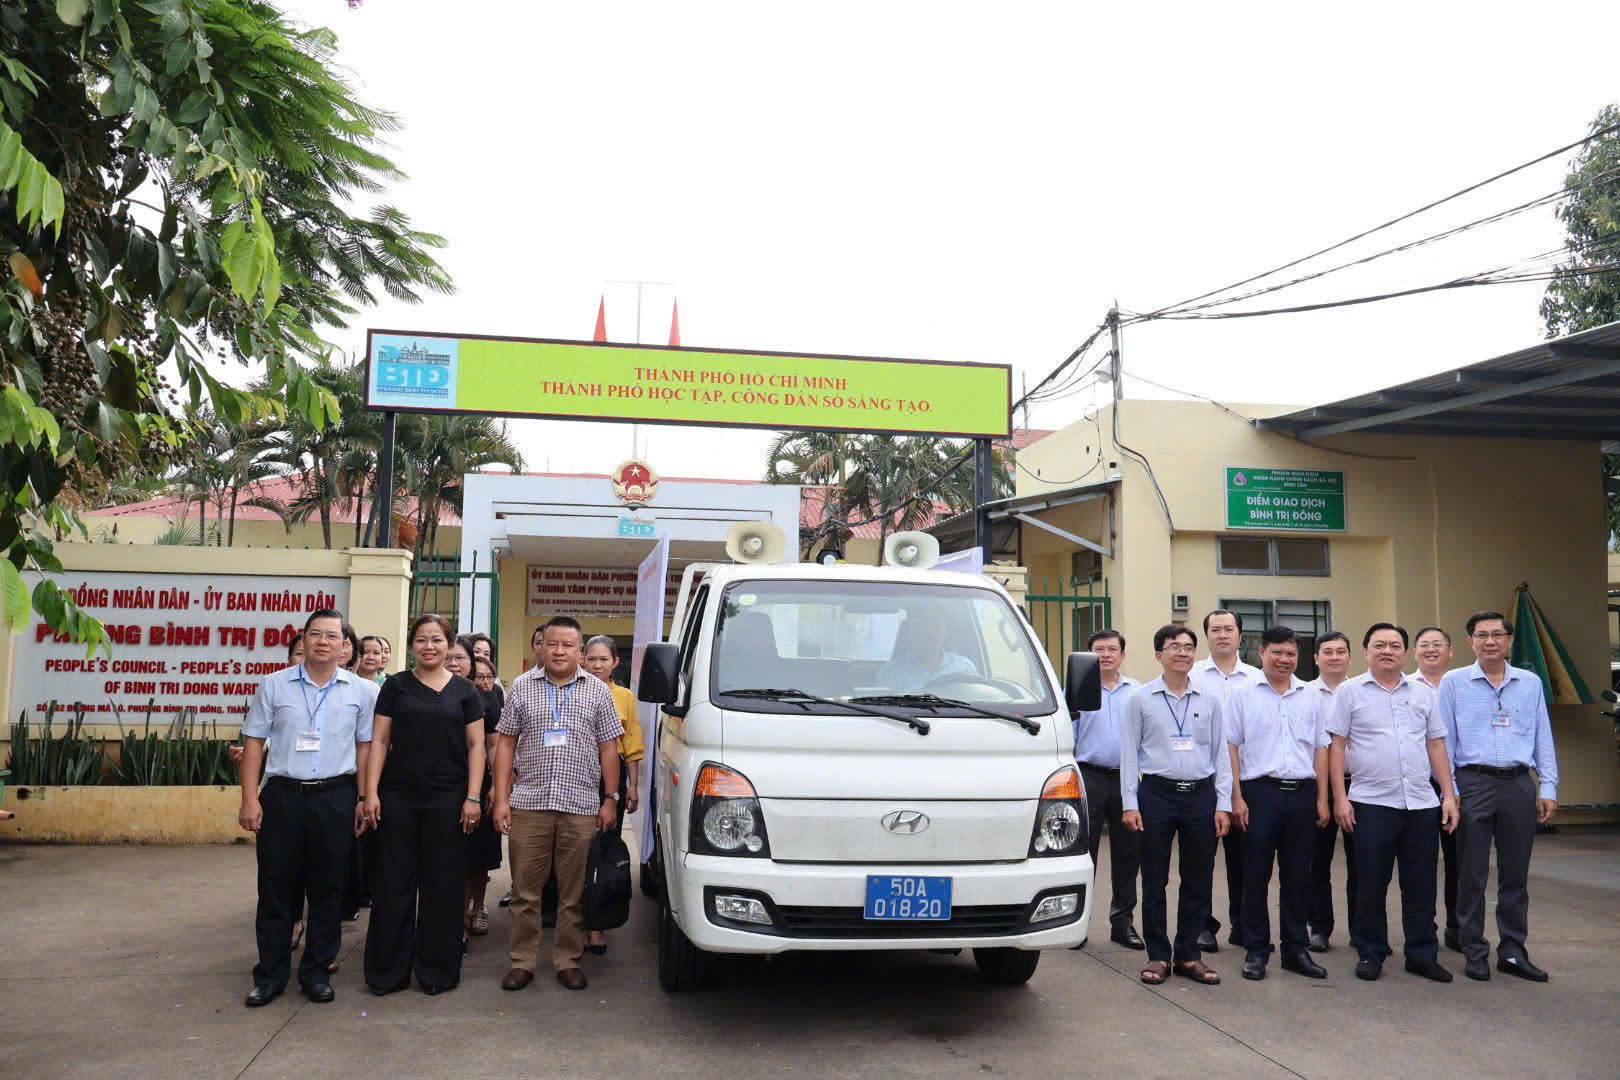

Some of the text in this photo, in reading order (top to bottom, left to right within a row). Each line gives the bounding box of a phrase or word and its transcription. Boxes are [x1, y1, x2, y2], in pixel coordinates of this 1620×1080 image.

[804, 376, 847, 391] MINH
[648, 387, 686, 403] HỌC
[731, 388, 779, 405] CÔNG
[784, 390, 819, 407] DÂN
[1247, 492, 1326, 510] ĐIỂM GIAO DỊCH
[1250, 508, 1322, 522] BÌNH TRỊ ĐÔNG
[113, 586, 154, 609] NHÂN
[159, 587, 189, 609] DÂN
[204, 586, 223, 611] ỦY
[227, 592, 257, 611] BAN
[261, 590, 301, 612] NHÂN
[305, 590, 335, 612] DÂN
[149, 622, 210, 645] BÌNH
[218, 626, 256, 651] TRỊ
[45, 657, 108, 672] PEOPLE'S
[112, 660, 167, 674] COUNCIL
[181, 659, 241, 674] PEOPLE'S
[104, 681, 121, 693] OF
[124, 681, 156, 694] BINH
[160, 682, 180, 694] TRI
[184, 682, 218, 695] DONG
[890, 878, 927, 897] 50A
[874, 899, 941, 917] 018.20
